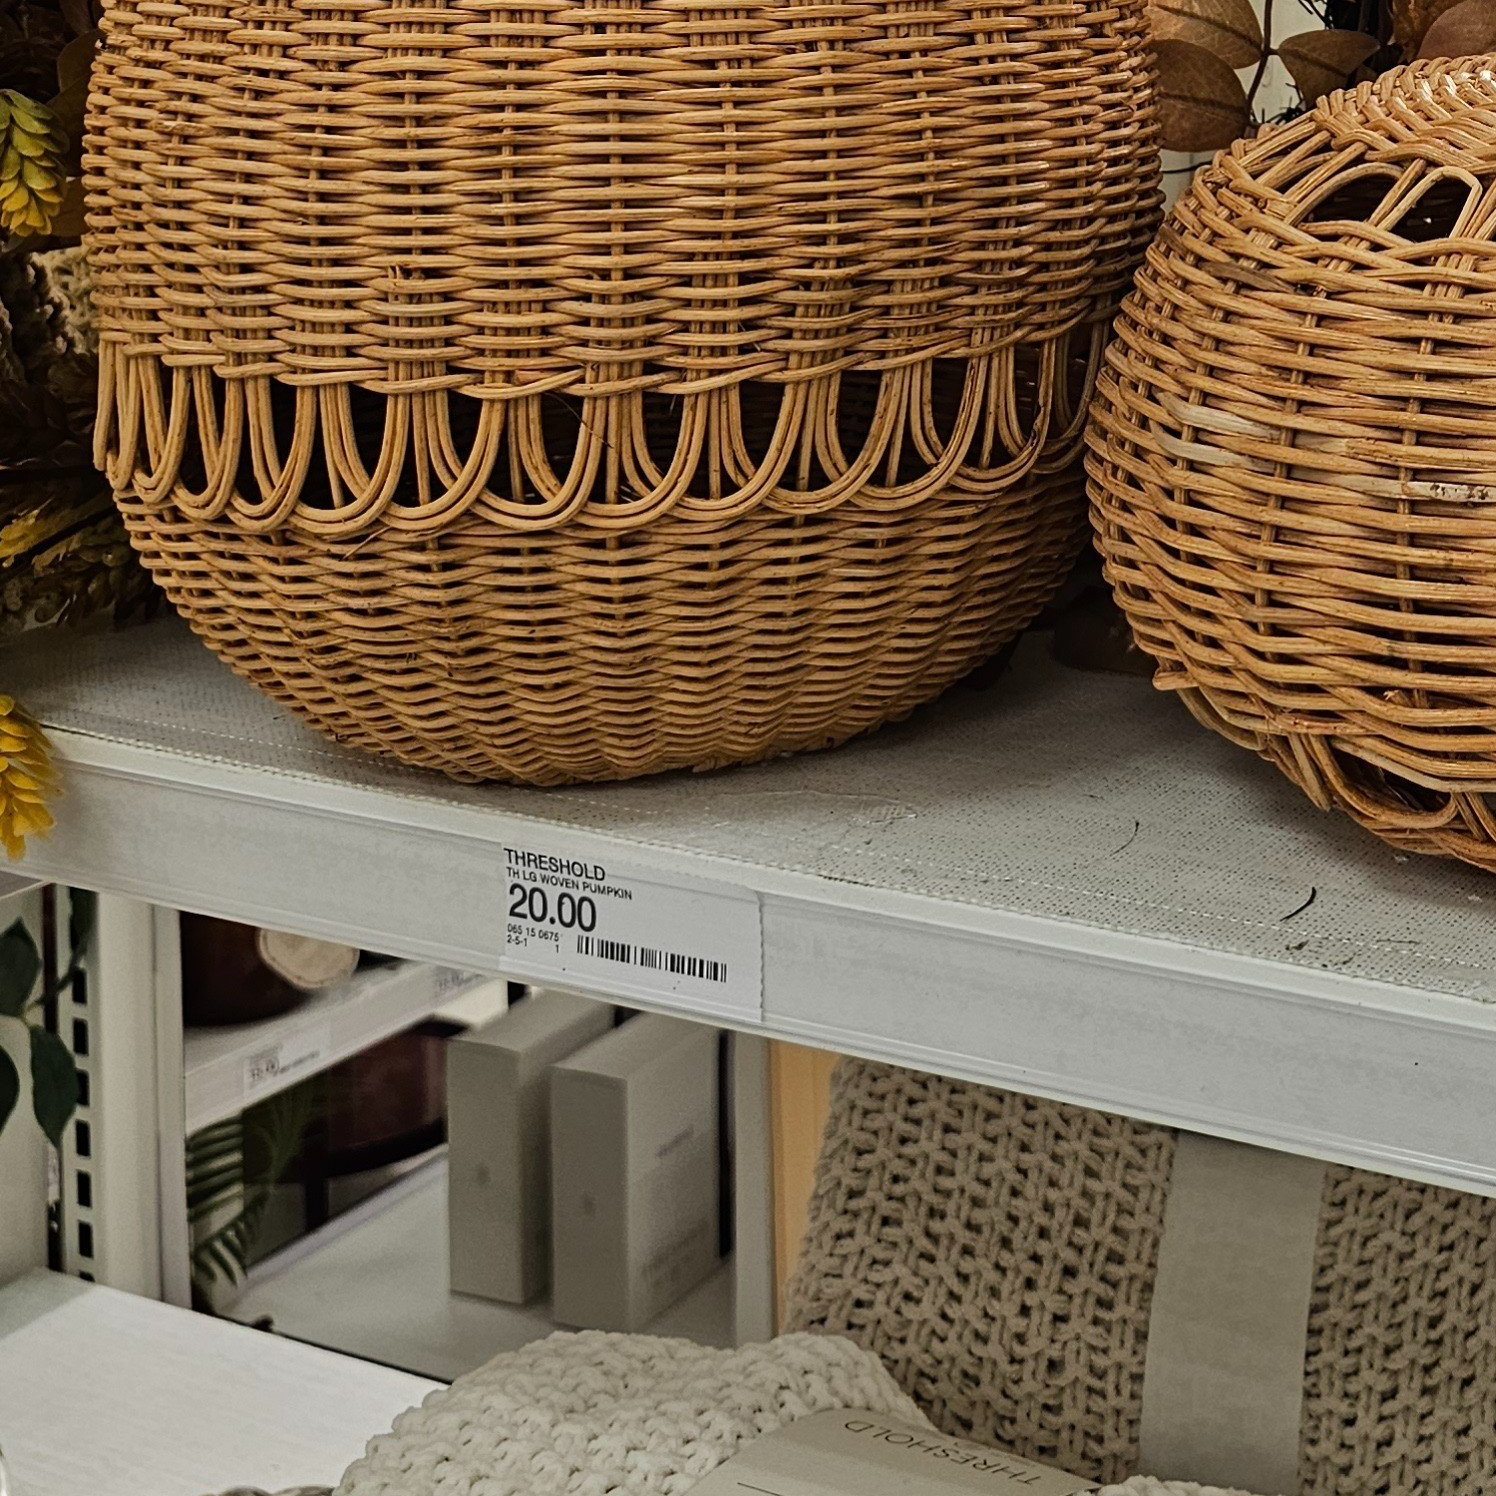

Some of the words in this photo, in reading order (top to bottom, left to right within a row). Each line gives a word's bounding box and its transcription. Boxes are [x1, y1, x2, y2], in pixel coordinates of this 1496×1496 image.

[503, 848, 605, 881] THRESHOLD
[506, 866, 520, 879] TH
[523, 870, 537, 882] LG
[540, 873, 579, 891] WOVEN
[582, 881, 632, 900] PUMPKIN
[509, 882, 597, 932] 20.00
[506, 934, 527, 947] 2-5-1
[507, 923, 523, 935] 065
[526, 927, 536, 938] 15
[538, 929, 559, 942] 0675
[844, 1420, 1042, 1486] THRESHOLD
